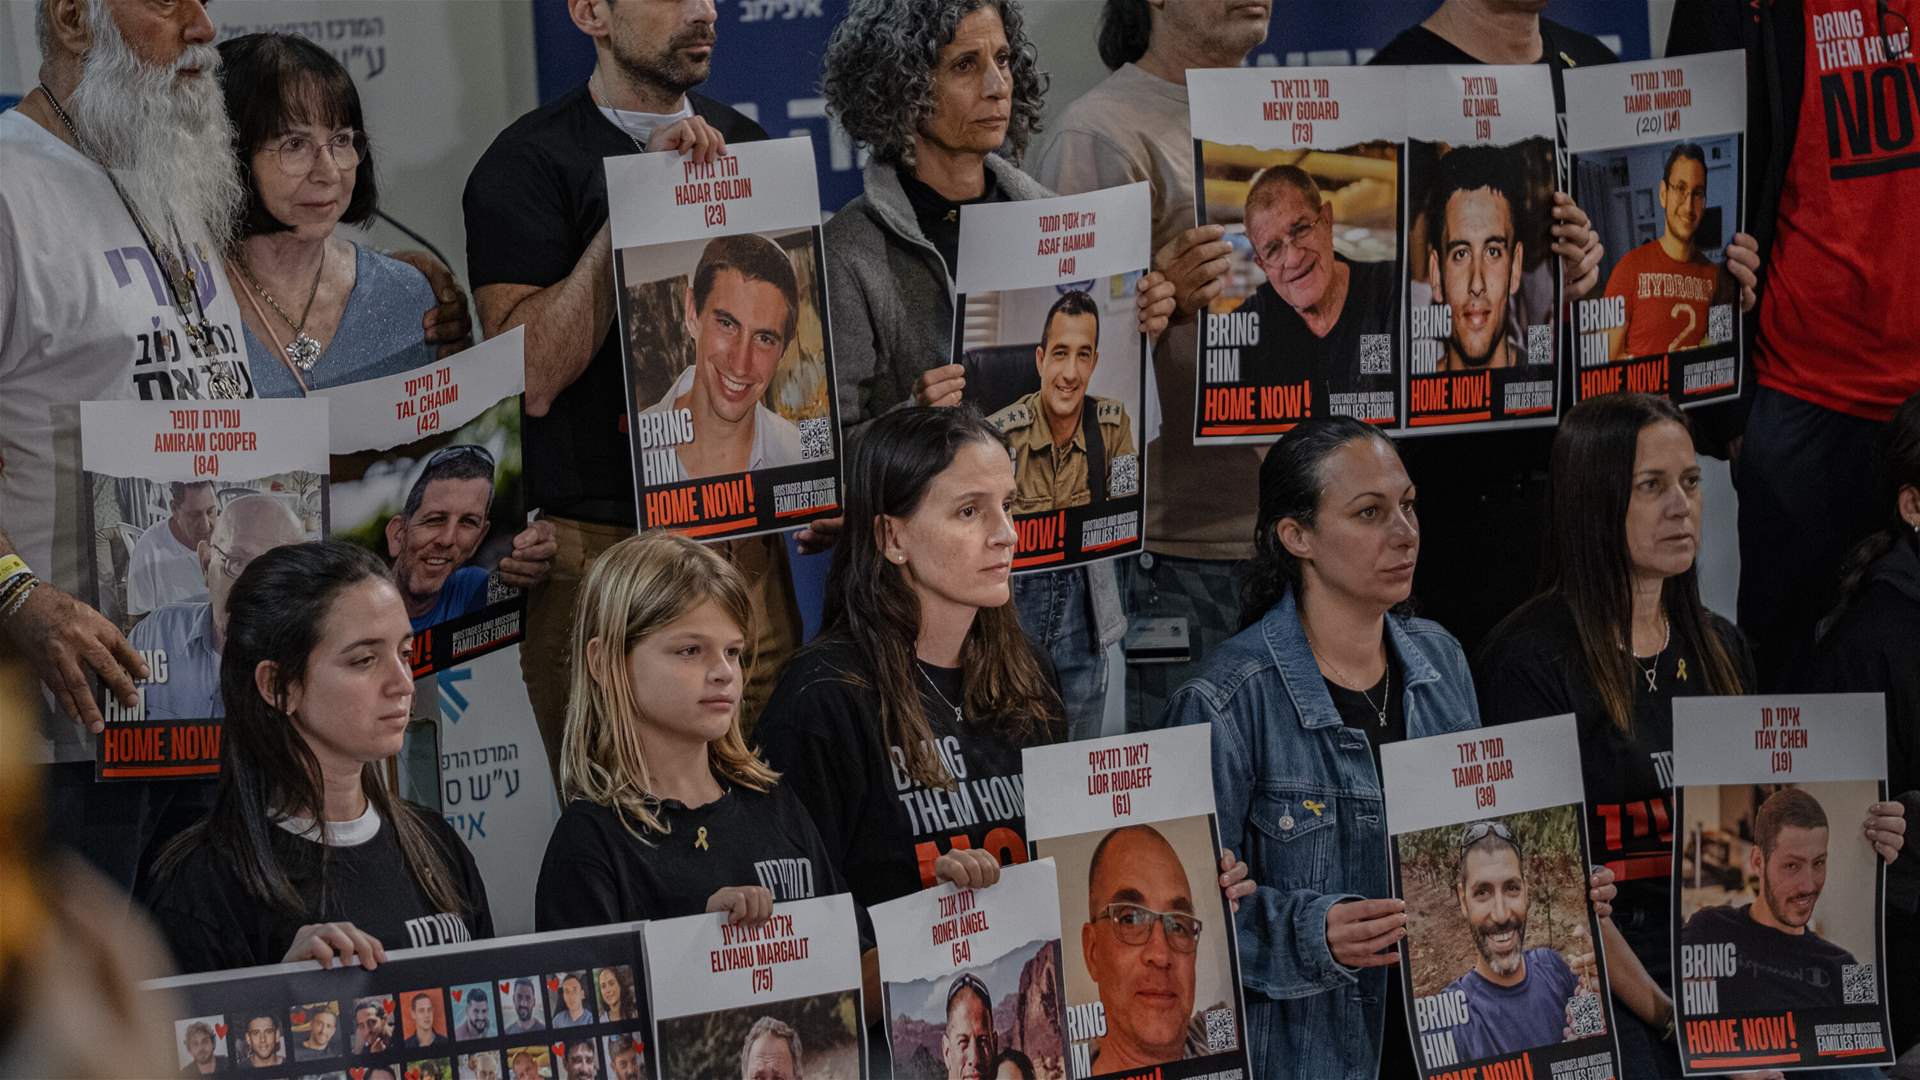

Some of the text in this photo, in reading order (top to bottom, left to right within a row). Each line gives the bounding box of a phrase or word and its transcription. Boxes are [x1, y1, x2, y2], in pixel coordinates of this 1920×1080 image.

[1813, 9, 1864, 43] BRING
[1816, 39, 1863, 72] THEM
[1663, 68, 1684, 88] תמיר
[1263, 101, 1339, 121] MENY GODARD
[1463, 98, 1501, 117] OZ DANIEL
[1623, 88, 1691, 114] TAMIR NIMRODI
[1820, 63, 1920, 160] NO
[1292, 122, 1313, 145] (73)
[1476, 119, 1491, 140] (19)
[1636, 114, 1662, 137] (20)
[675, 178, 752, 206] HADAR GOLDIN
[704, 202, 727, 228] (23)
[1038, 232, 1095, 256] ASAF HAMAMI
[1058, 256, 1076, 277] (40)
[1411, 303, 1452, 338] BRING
[1579, 295, 1625, 333] BRING
[1207, 311, 1260, 347] BRING
[1411, 339, 1437, 375] HIM
[1580, 331, 1609, 367] HIM
[437, 366, 451, 388] טל
[1206, 348, 1240, 383] HIM
[1581, 354, 1669, 401] HOME NOW!
[396, 383, 458, 421] TAL CHAIMI
[1205, 379, 1312, 421] HOME NOW!
[1411, 370, 1491, 412] HOME NOW!
[1504, 393, 1530, 410] FAMILIES
[169, 409, 240, 430] עמירם קופר
[416, 411, 440, 435] (42)
[1330, 403, 1393, 420] FAMILIES FORUM
[154, 431, 257, 453] AMIRAM COOPER
[640, 408, 694, 450] BRING
[193, 454, 219, 477] (84)
[642, 447, 679, 487] HIM
[645, 473, 755, 529] HOME NOW!
[774, 487, 836, 514] FAMILIES FORUM
[1014, 510, 1066, 553] NOW!
[1082, 522, 1138, 547] FAMILIES FORUM
[452, 632, 489, 656] FAMILIES
[490, 619, 520, 642] FORUM
[482, 619, 494, 631] AND
[1761, 706, 1800, 730] איתי חן
[104, 725, 221, 763] HOME NOW
[474, 743, 519, 764] המרכז
[1457, 737, 1504, 764] תמיר אדר
[1755, 729, 1808, 750] ITAY CHEN
[1089, 742, 1149, 774] ליאור רודאיף
[1772, 750, 1792, 774] (19)
[470, 768, 520, 801] ע"ש
[1088, 767, 1153, 796] LIOR RUDAEFF
[1452, 759, 1514, 788] TAMIR ADAR
[898, 775, 1025, 836] THEM HOM
[1112, 792, 1131, 818] (61)
[1476, 783, 1496, 811] (38)
[938, 894, 958, 919] אנגל
[932, 910, 990, 946] RONEN ANGEL
[710, 937, 809, 973] ELIYAHU MARGALIT
[952, 938, 971, 966] (54)
[1681, 942, 1737, 978] BRING
[752, 966, 773, 994] (75)
[1414, 989, 1470, 1032] BRING
[1682, 979, 1719, 1016] HIM
[1067, 1001, 1107, 1041] RING
[1685, 1011, 1798, 1055] HOME NOW!
[1421, 1030, 1459, 1070] HIM
[1816, 1033, 1884, 1054] FAMILIES FORUM
[1071, 1042, 1092, 1080] IM
